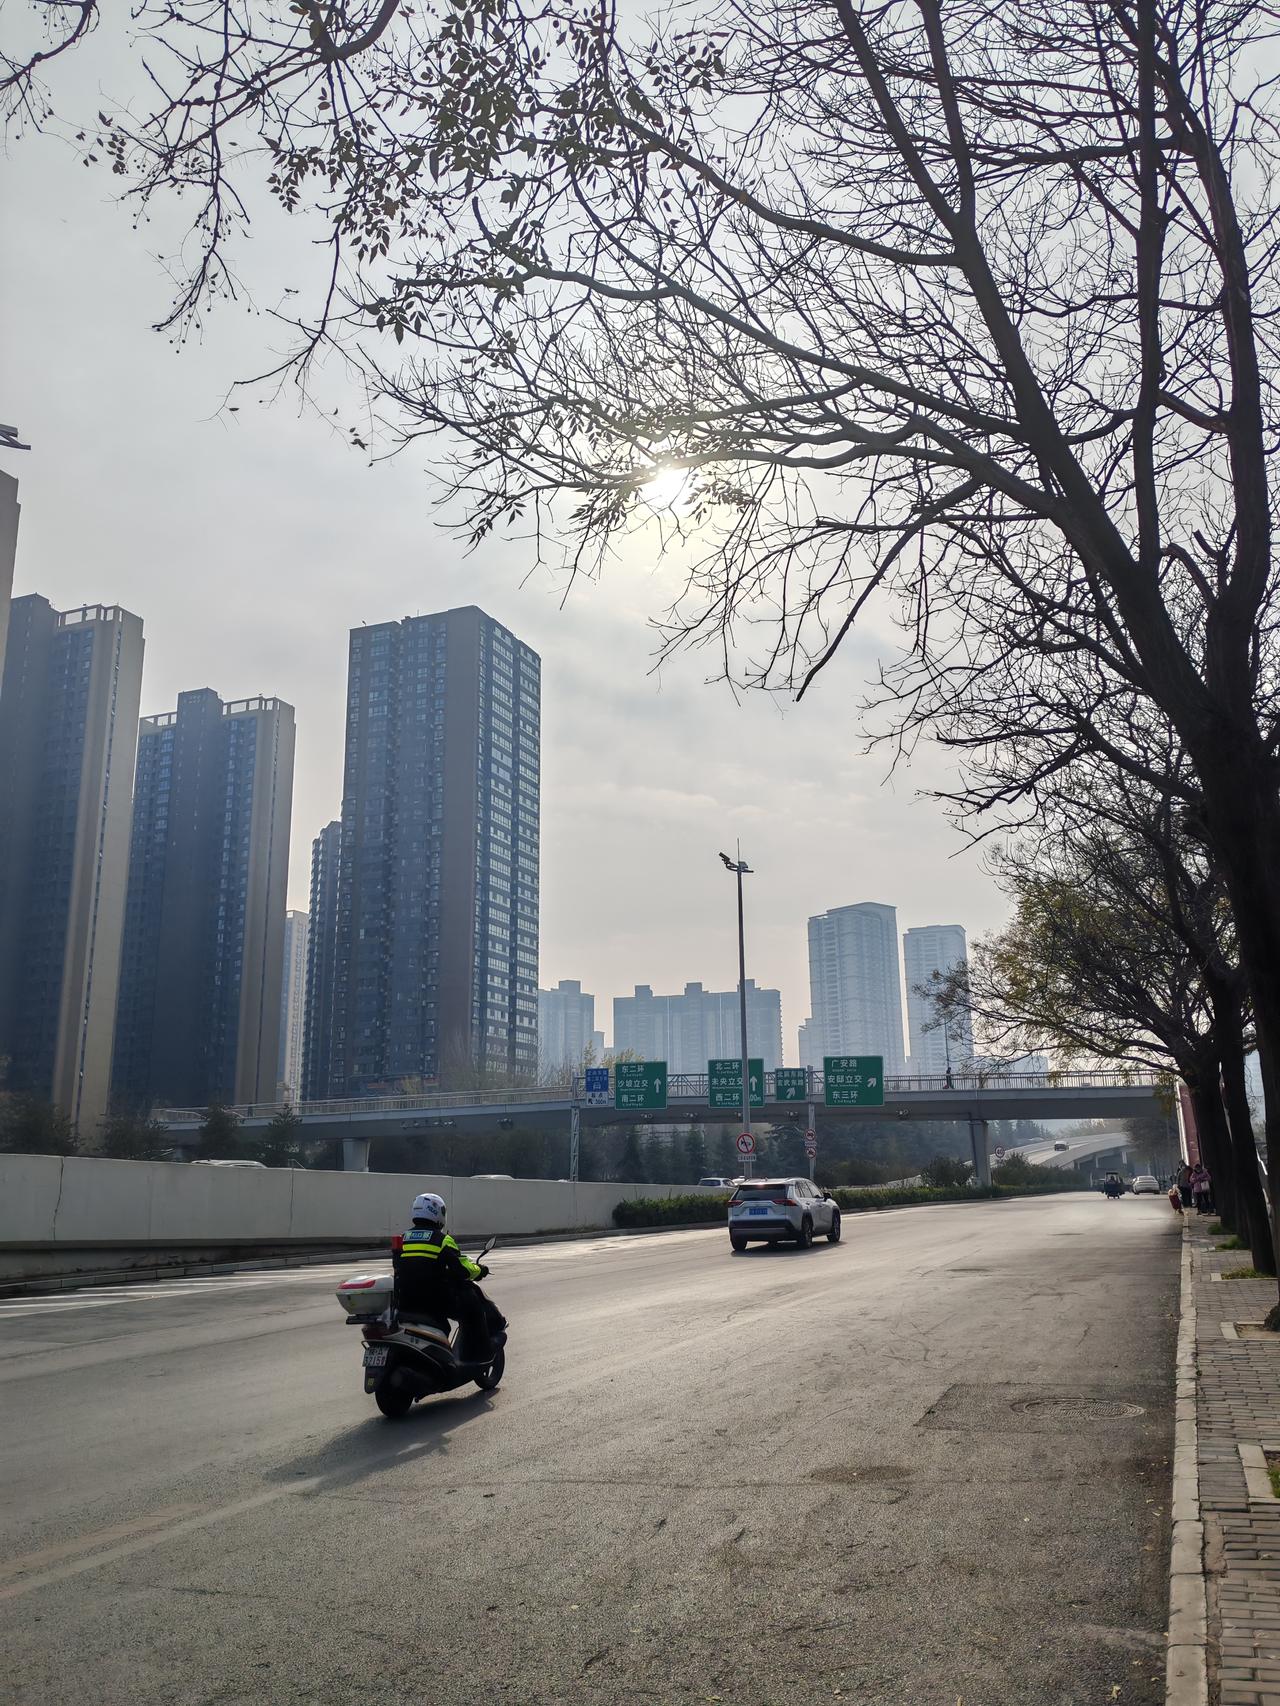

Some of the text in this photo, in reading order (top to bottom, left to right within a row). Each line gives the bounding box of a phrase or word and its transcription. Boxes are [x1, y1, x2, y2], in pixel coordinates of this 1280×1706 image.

[715, 1062, 740, 1070] 北二环
[831, 1059, 857, 1068] 广安路
[622, 1064, 645, 1073] 东二环
[711, 1077, 743, 1086] 未央立交
[621, 1094, 645, 1103] 南二环
[715, 1093, 740, 1102] 西二环
[832, 1090, 858, 1099] 东三环
